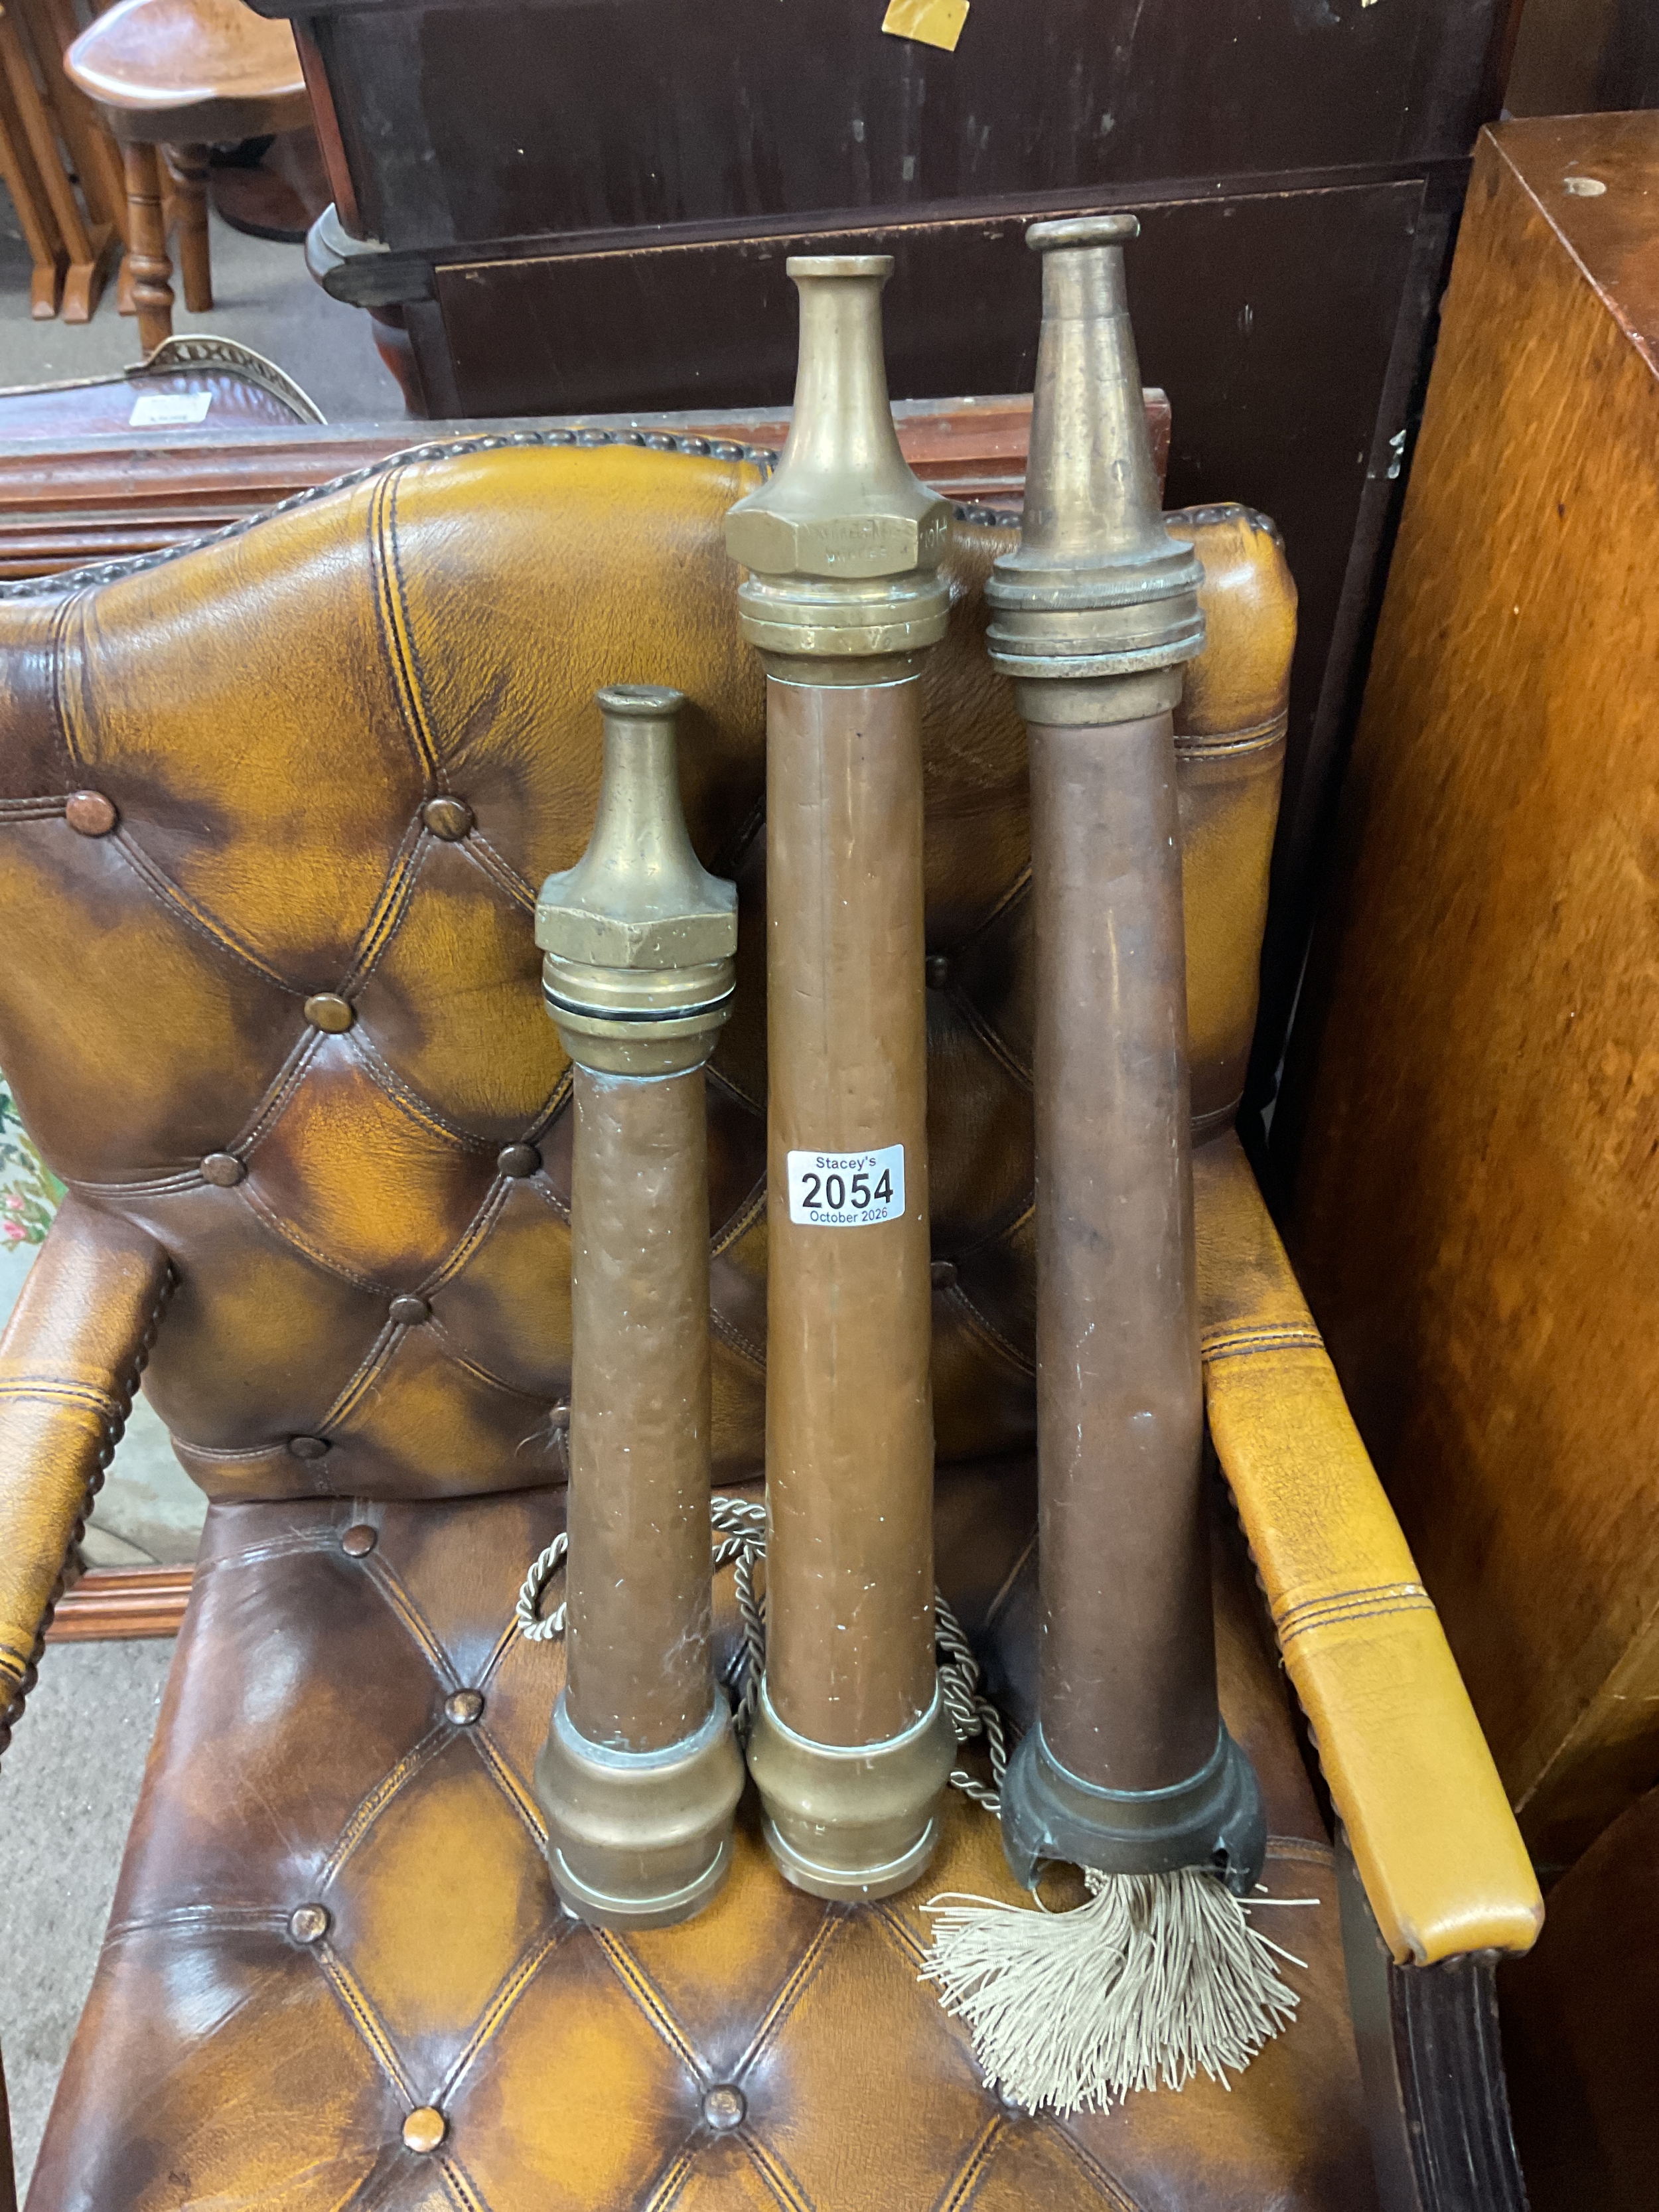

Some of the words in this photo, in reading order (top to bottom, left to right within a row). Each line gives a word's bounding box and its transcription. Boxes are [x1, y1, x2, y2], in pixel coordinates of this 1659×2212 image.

[816, 1156, 877, 1171] Stacey's
[802, 1168, 894, 1209] 2054
[810, 1210, 858, 1223] October
[862, 1207, 888, 1222] 2026
